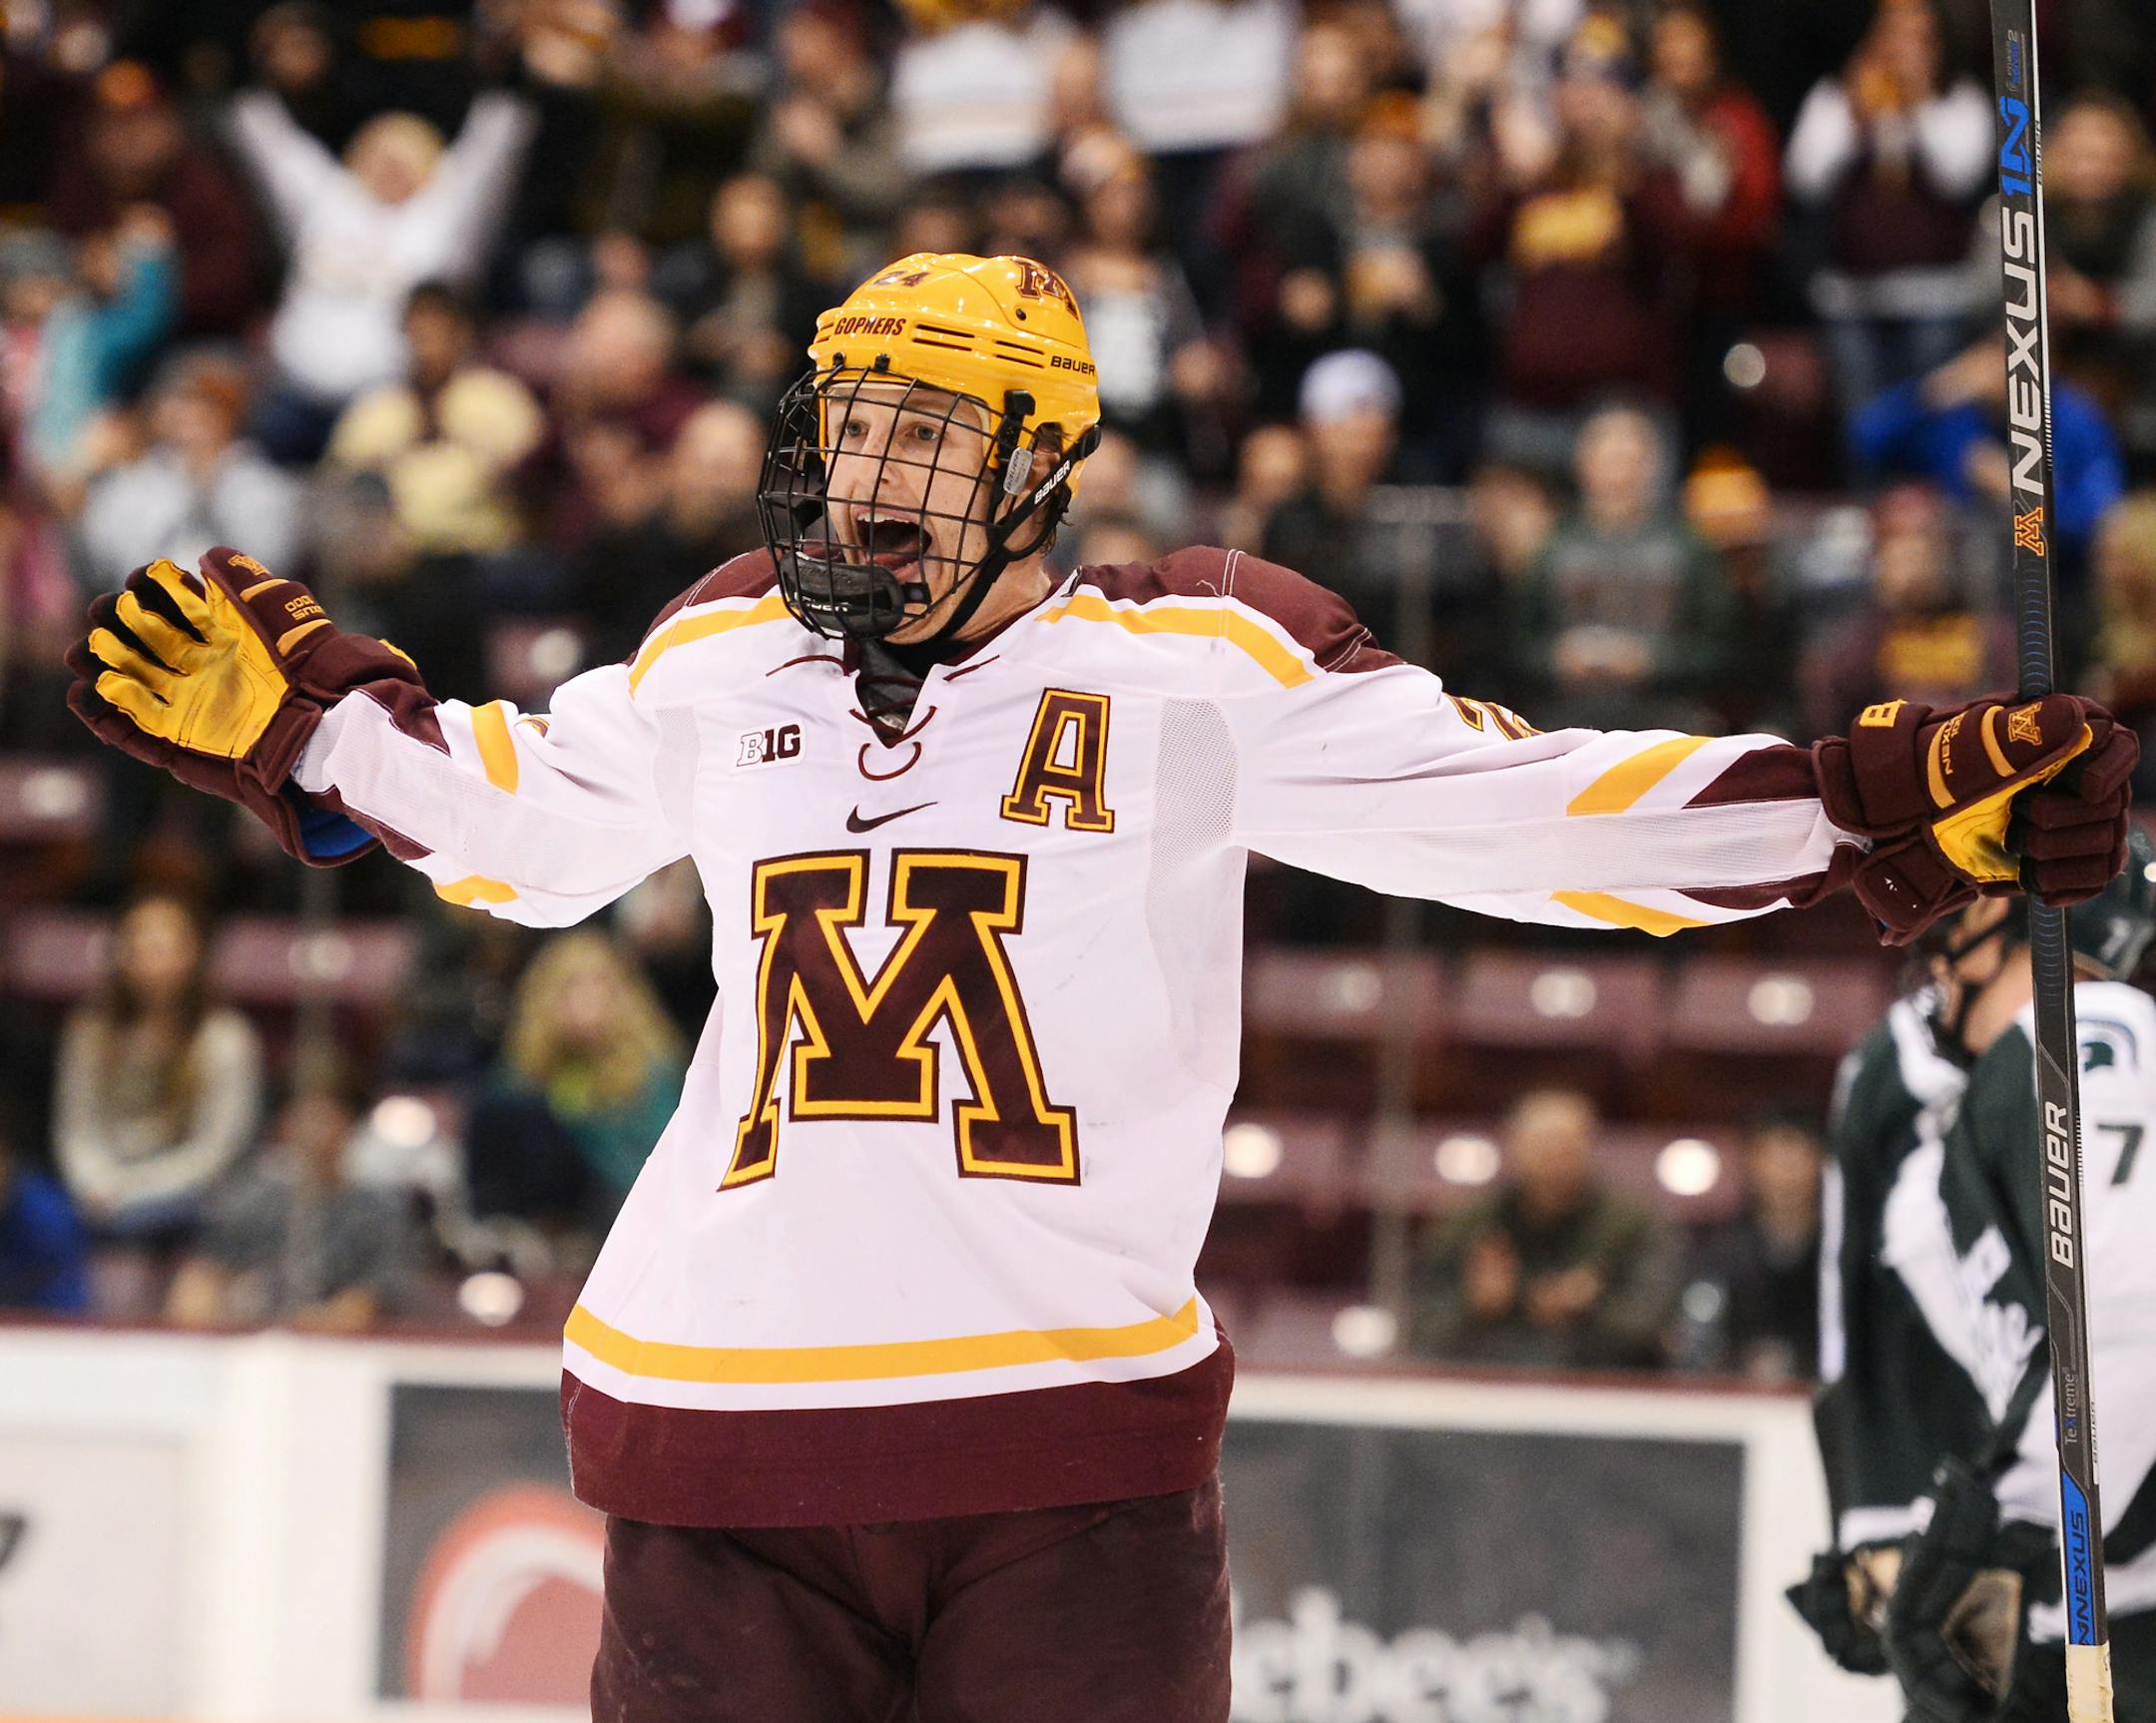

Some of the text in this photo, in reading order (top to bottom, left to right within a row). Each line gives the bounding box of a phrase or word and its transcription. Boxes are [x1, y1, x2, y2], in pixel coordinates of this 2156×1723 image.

[833, 316, 906, 336] GOPHERS
[2002, 207, 2044, 496] NEXUS
[1050, 355, 1096, 375] BAUER
[1034, 459, 1071, 505] BAUER
[2013, 505, 2045, 557] M
[999, 687, 1115, 833] A
[716, 848, 1081, 1193] M
[2044, 1101, 2074, 1269] BAUER
[2096, 1121, 2145, 1186] 7
